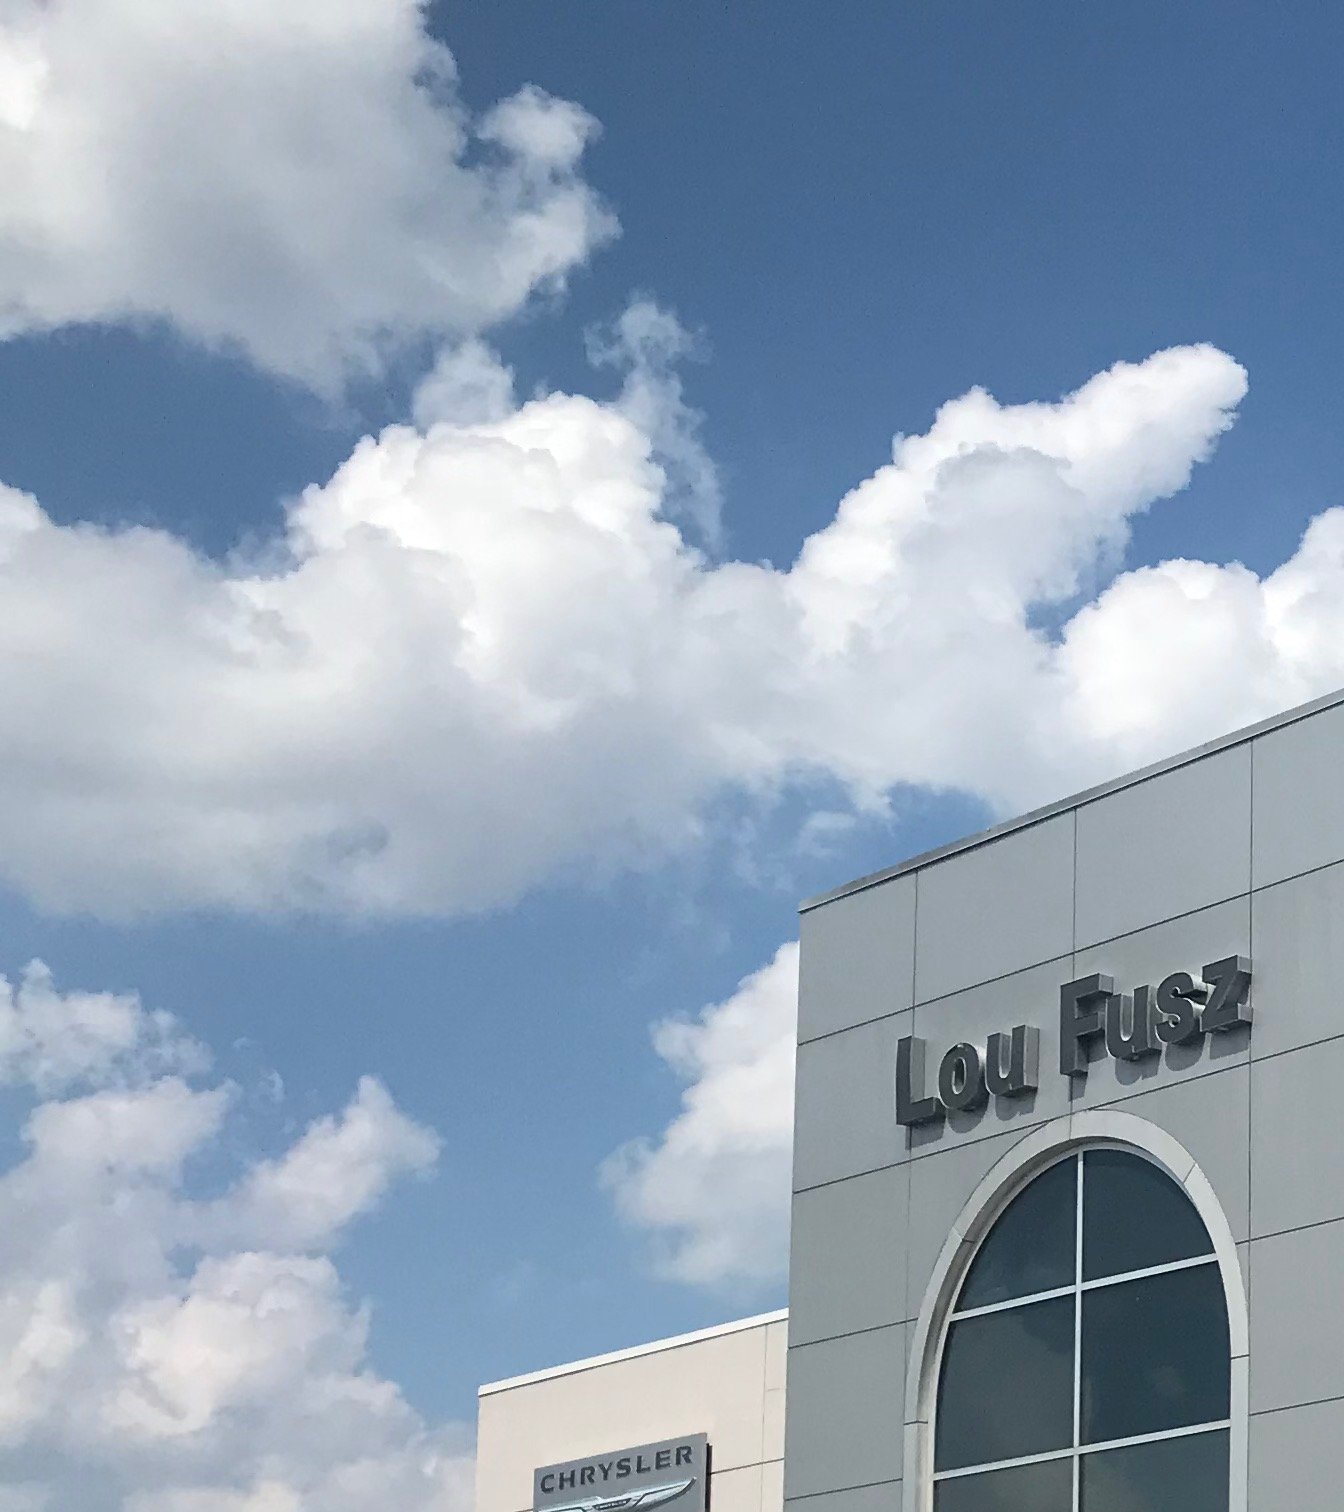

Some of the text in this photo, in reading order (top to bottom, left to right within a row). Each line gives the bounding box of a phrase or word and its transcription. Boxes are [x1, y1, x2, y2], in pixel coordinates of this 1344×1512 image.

[896, 954, 1253, 1126] Lou Fusz
[540, 1445, 693, 1494] CHRYSLER
